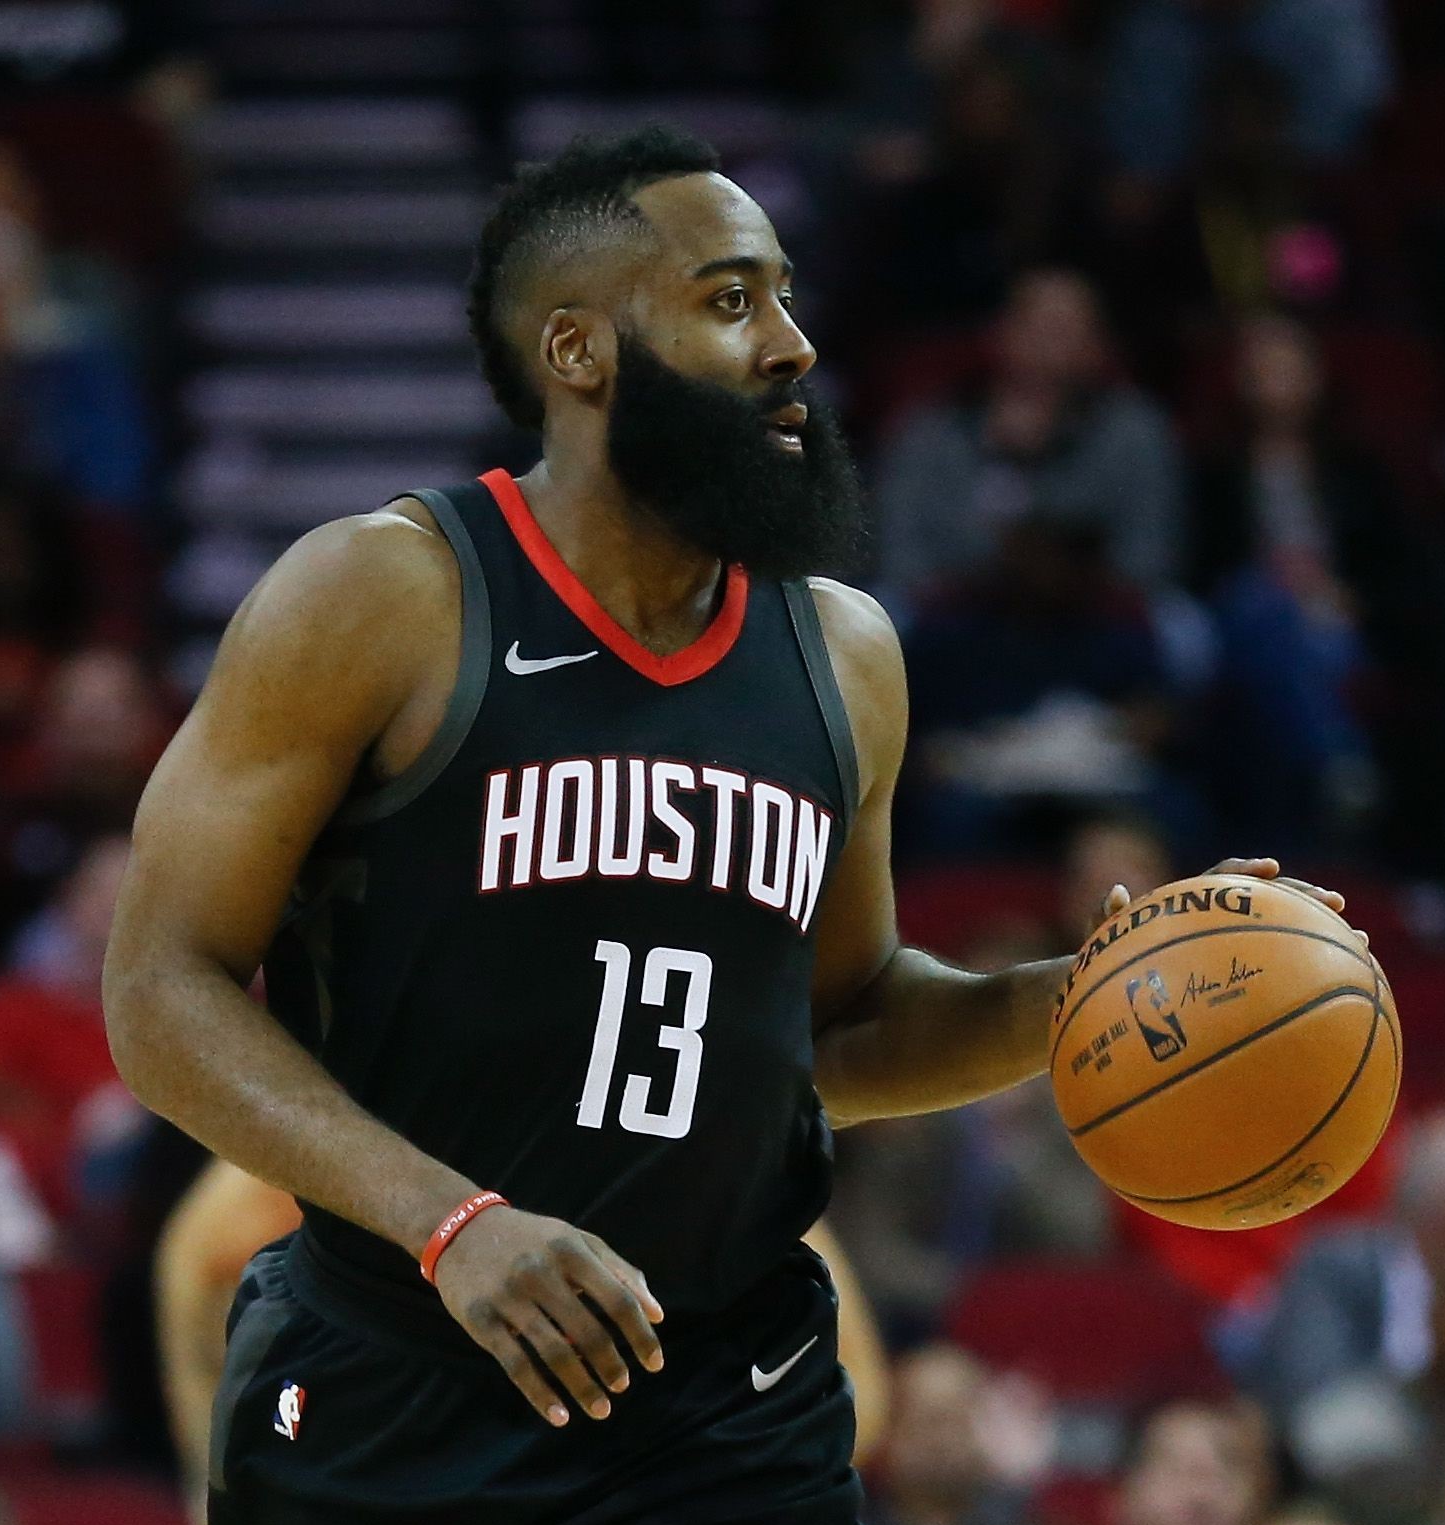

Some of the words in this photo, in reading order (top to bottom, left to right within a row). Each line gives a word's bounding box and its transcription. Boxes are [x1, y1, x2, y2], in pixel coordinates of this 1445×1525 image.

[478, 756, 834, 935] HOUSTON
[576, 939, 713, 1139] 13
[439, 1210, 466, 1239] PLAY
